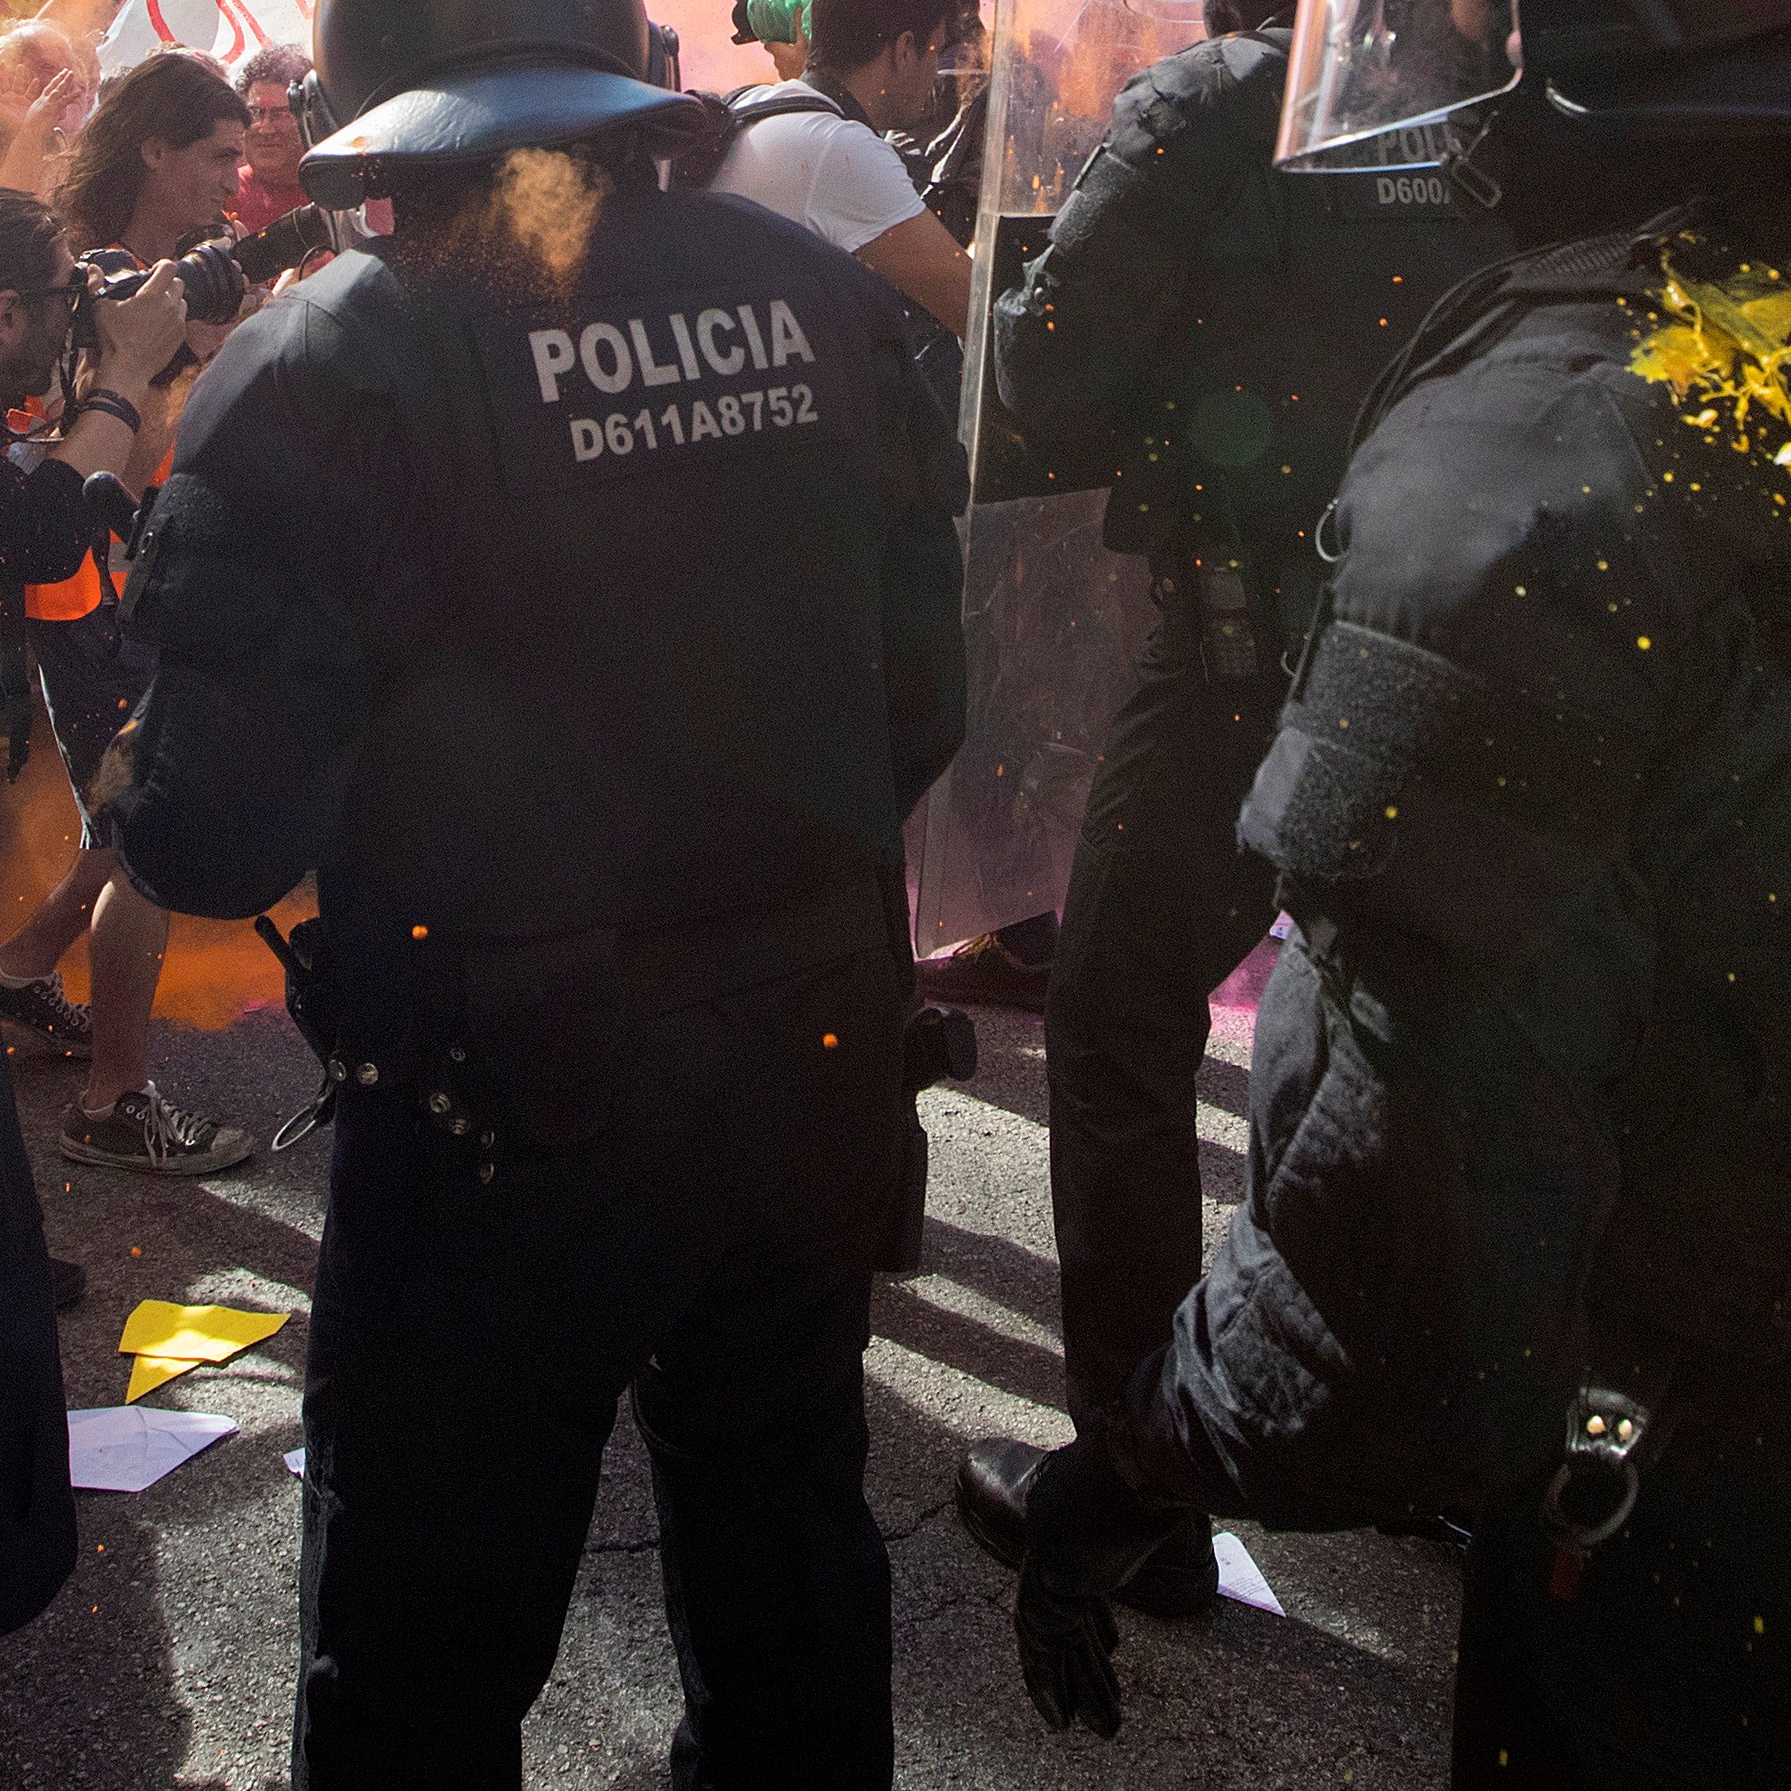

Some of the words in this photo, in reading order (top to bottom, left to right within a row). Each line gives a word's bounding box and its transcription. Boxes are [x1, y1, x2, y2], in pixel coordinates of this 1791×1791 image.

[1376, 176, 1451, 205] D600
[527, 298, 817, 403] POLICIA
[569, 382, 819, 462] D611A8752
